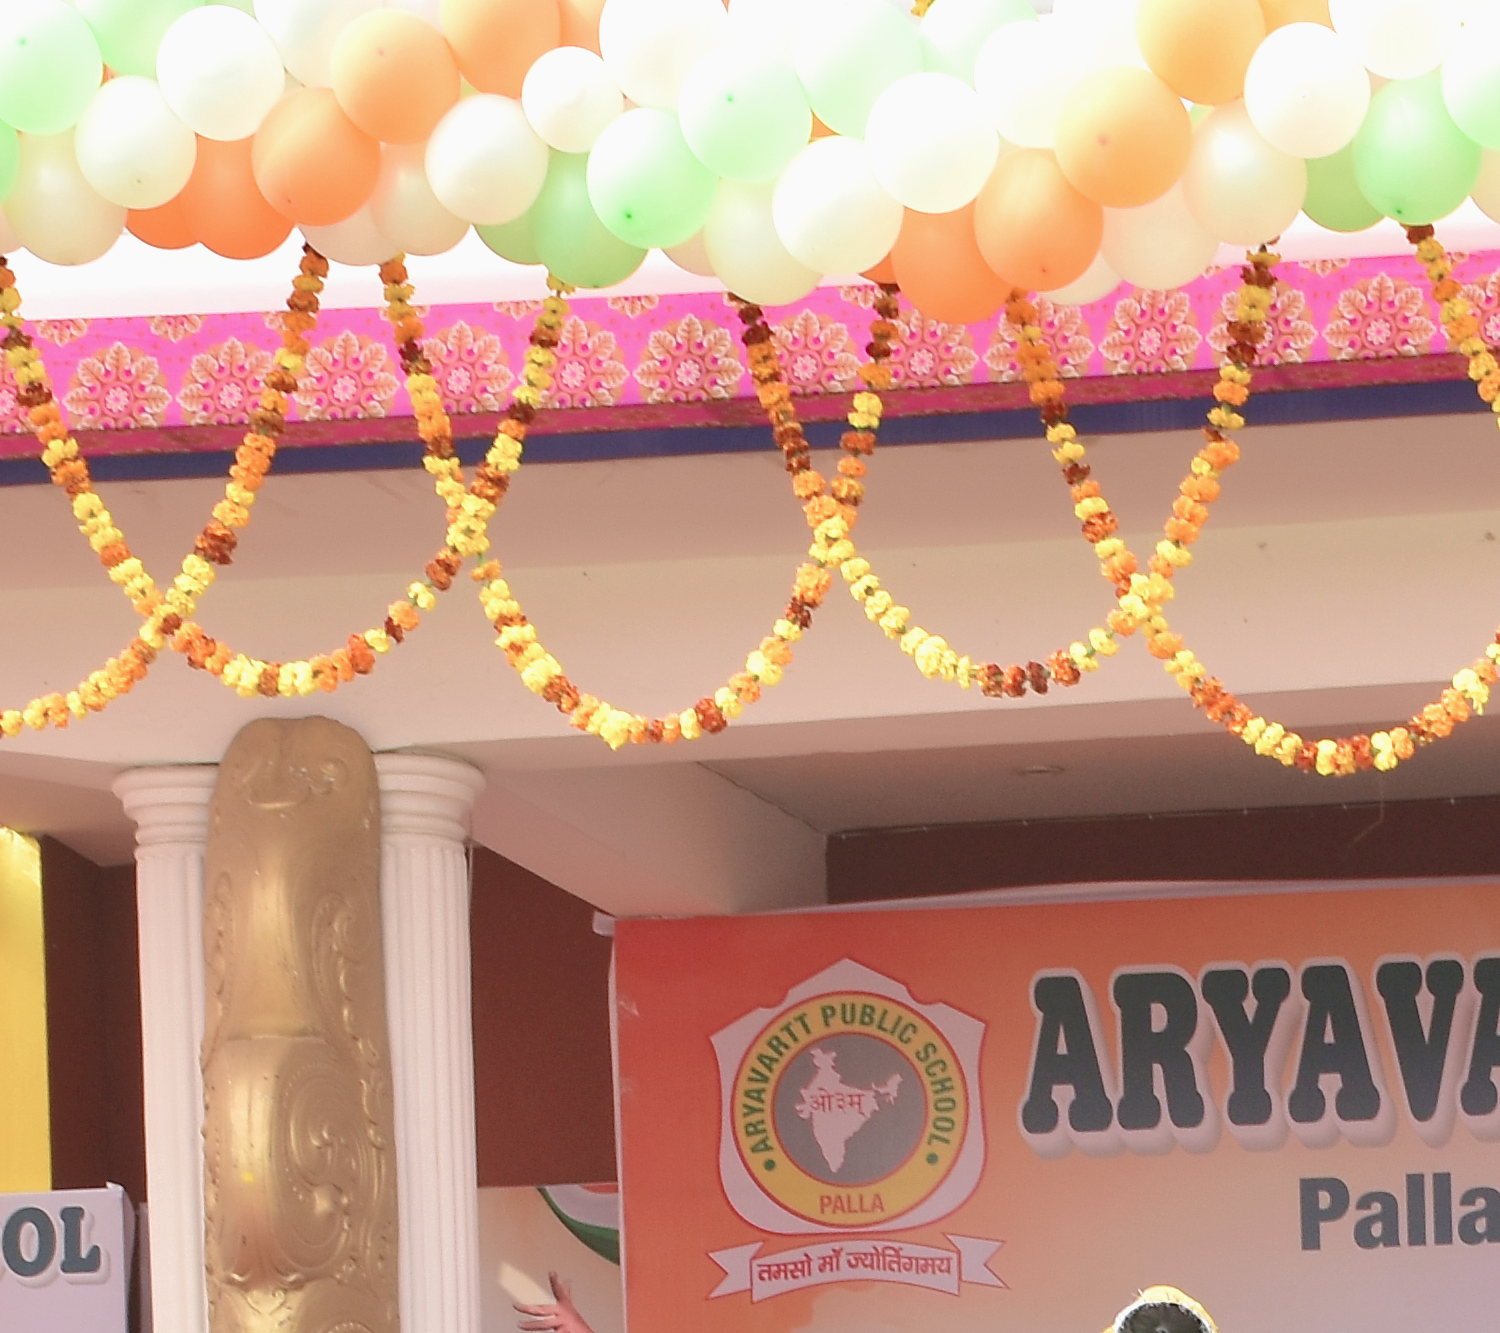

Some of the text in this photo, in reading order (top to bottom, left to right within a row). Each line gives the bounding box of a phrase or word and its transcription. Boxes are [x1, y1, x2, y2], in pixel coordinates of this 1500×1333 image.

[742, 1002, 956, 1154] ARYAVARTT PUBLIC SCHOOL
[818, 1193, 886, 1215] PALLA
[756, 1252, 812, 1283] तमसो
